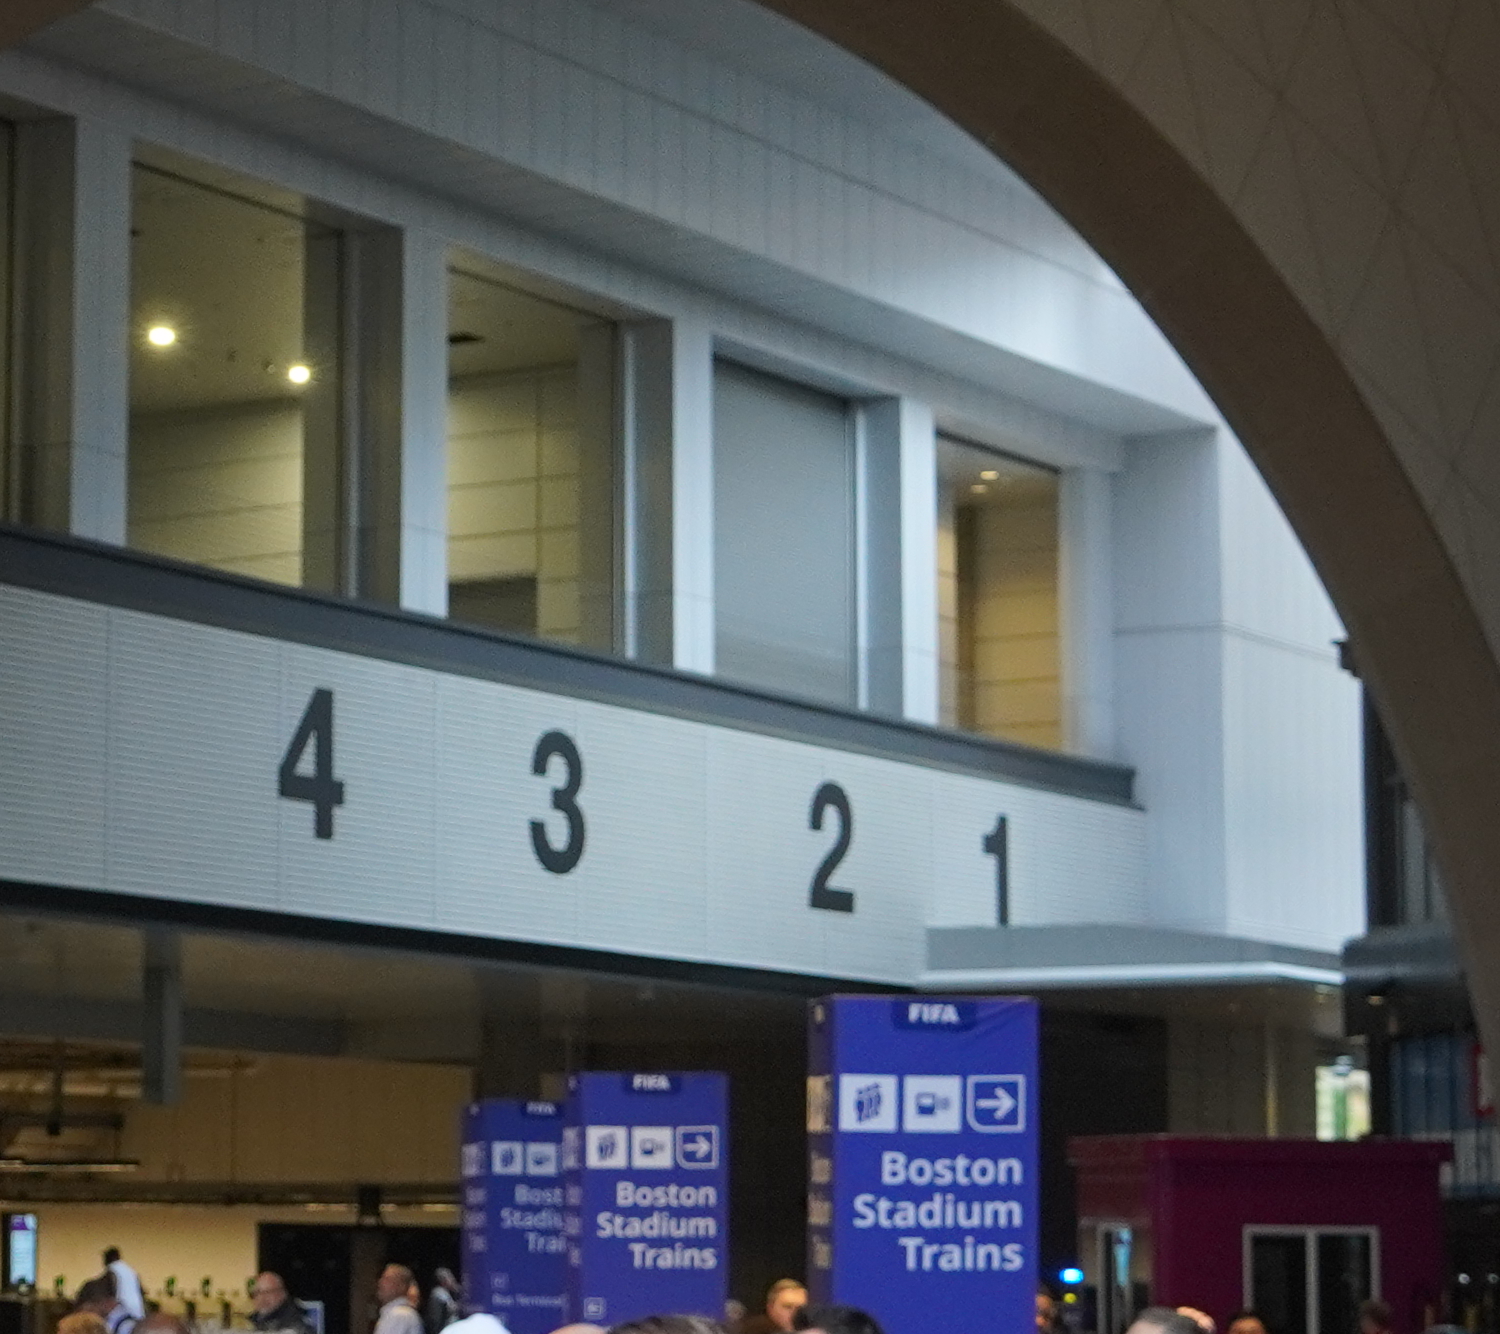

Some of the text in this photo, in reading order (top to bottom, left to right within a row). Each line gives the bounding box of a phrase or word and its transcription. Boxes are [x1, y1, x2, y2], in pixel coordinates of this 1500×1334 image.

[278, 687, 345, 839] 4
[530, 730, 587, 874] 3
[809, 782, 857, 913] 2
[981, 814, 1010, 925] 1
[908, 1003, 960, 1024] FIFA
[632, 1075, 671, 1092] FIFA
[881, 1151, 1024, 1186] Boston
[616, 1181, 717, 1208] Boston
[596, 1210, 717, 1239] Stadium
[852, 1193, 1023, 1228] Stadium
[628, 1242, 718, 1270] Trains
[898, 1237, 1024, 1271] Trains
